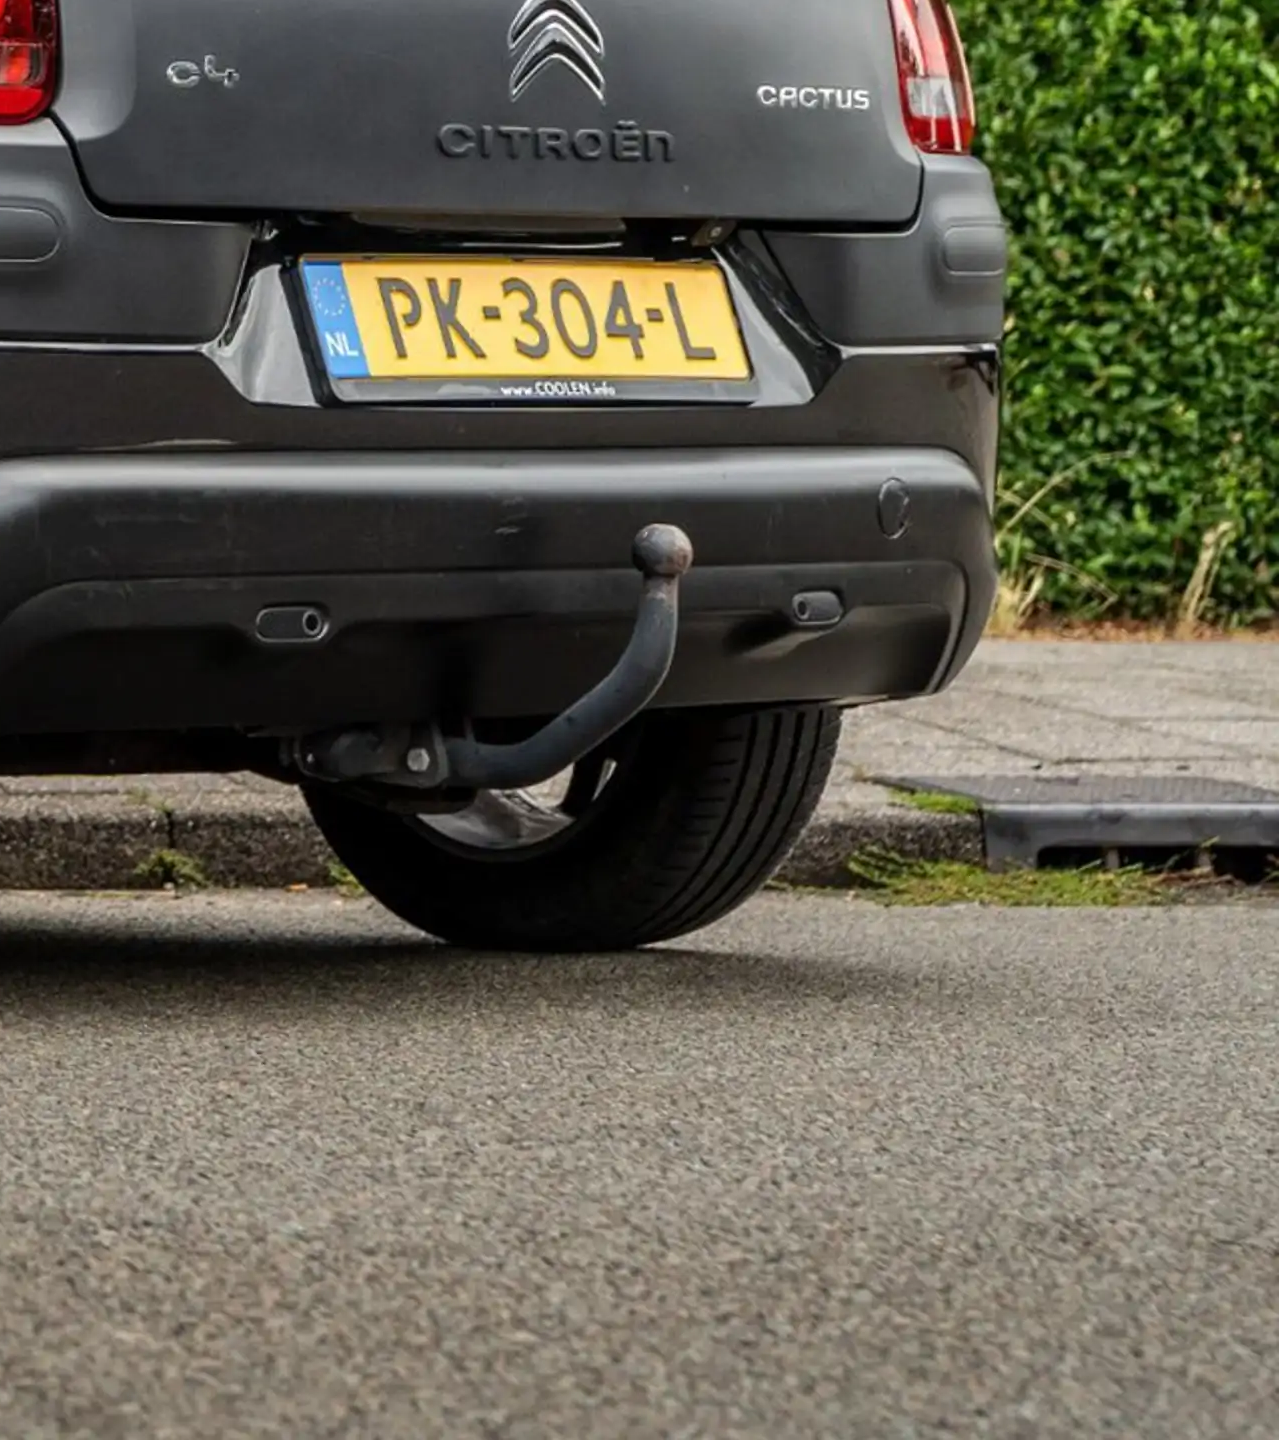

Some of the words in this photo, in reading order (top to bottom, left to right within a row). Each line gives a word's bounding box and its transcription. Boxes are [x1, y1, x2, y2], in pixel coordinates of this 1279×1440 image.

[165, 53, 241, 89] C4
[756, 84, 870, 110] CACTUS
[375, 276, 718, 362] PK-304-L
[325, 331, 360, 357] NL
